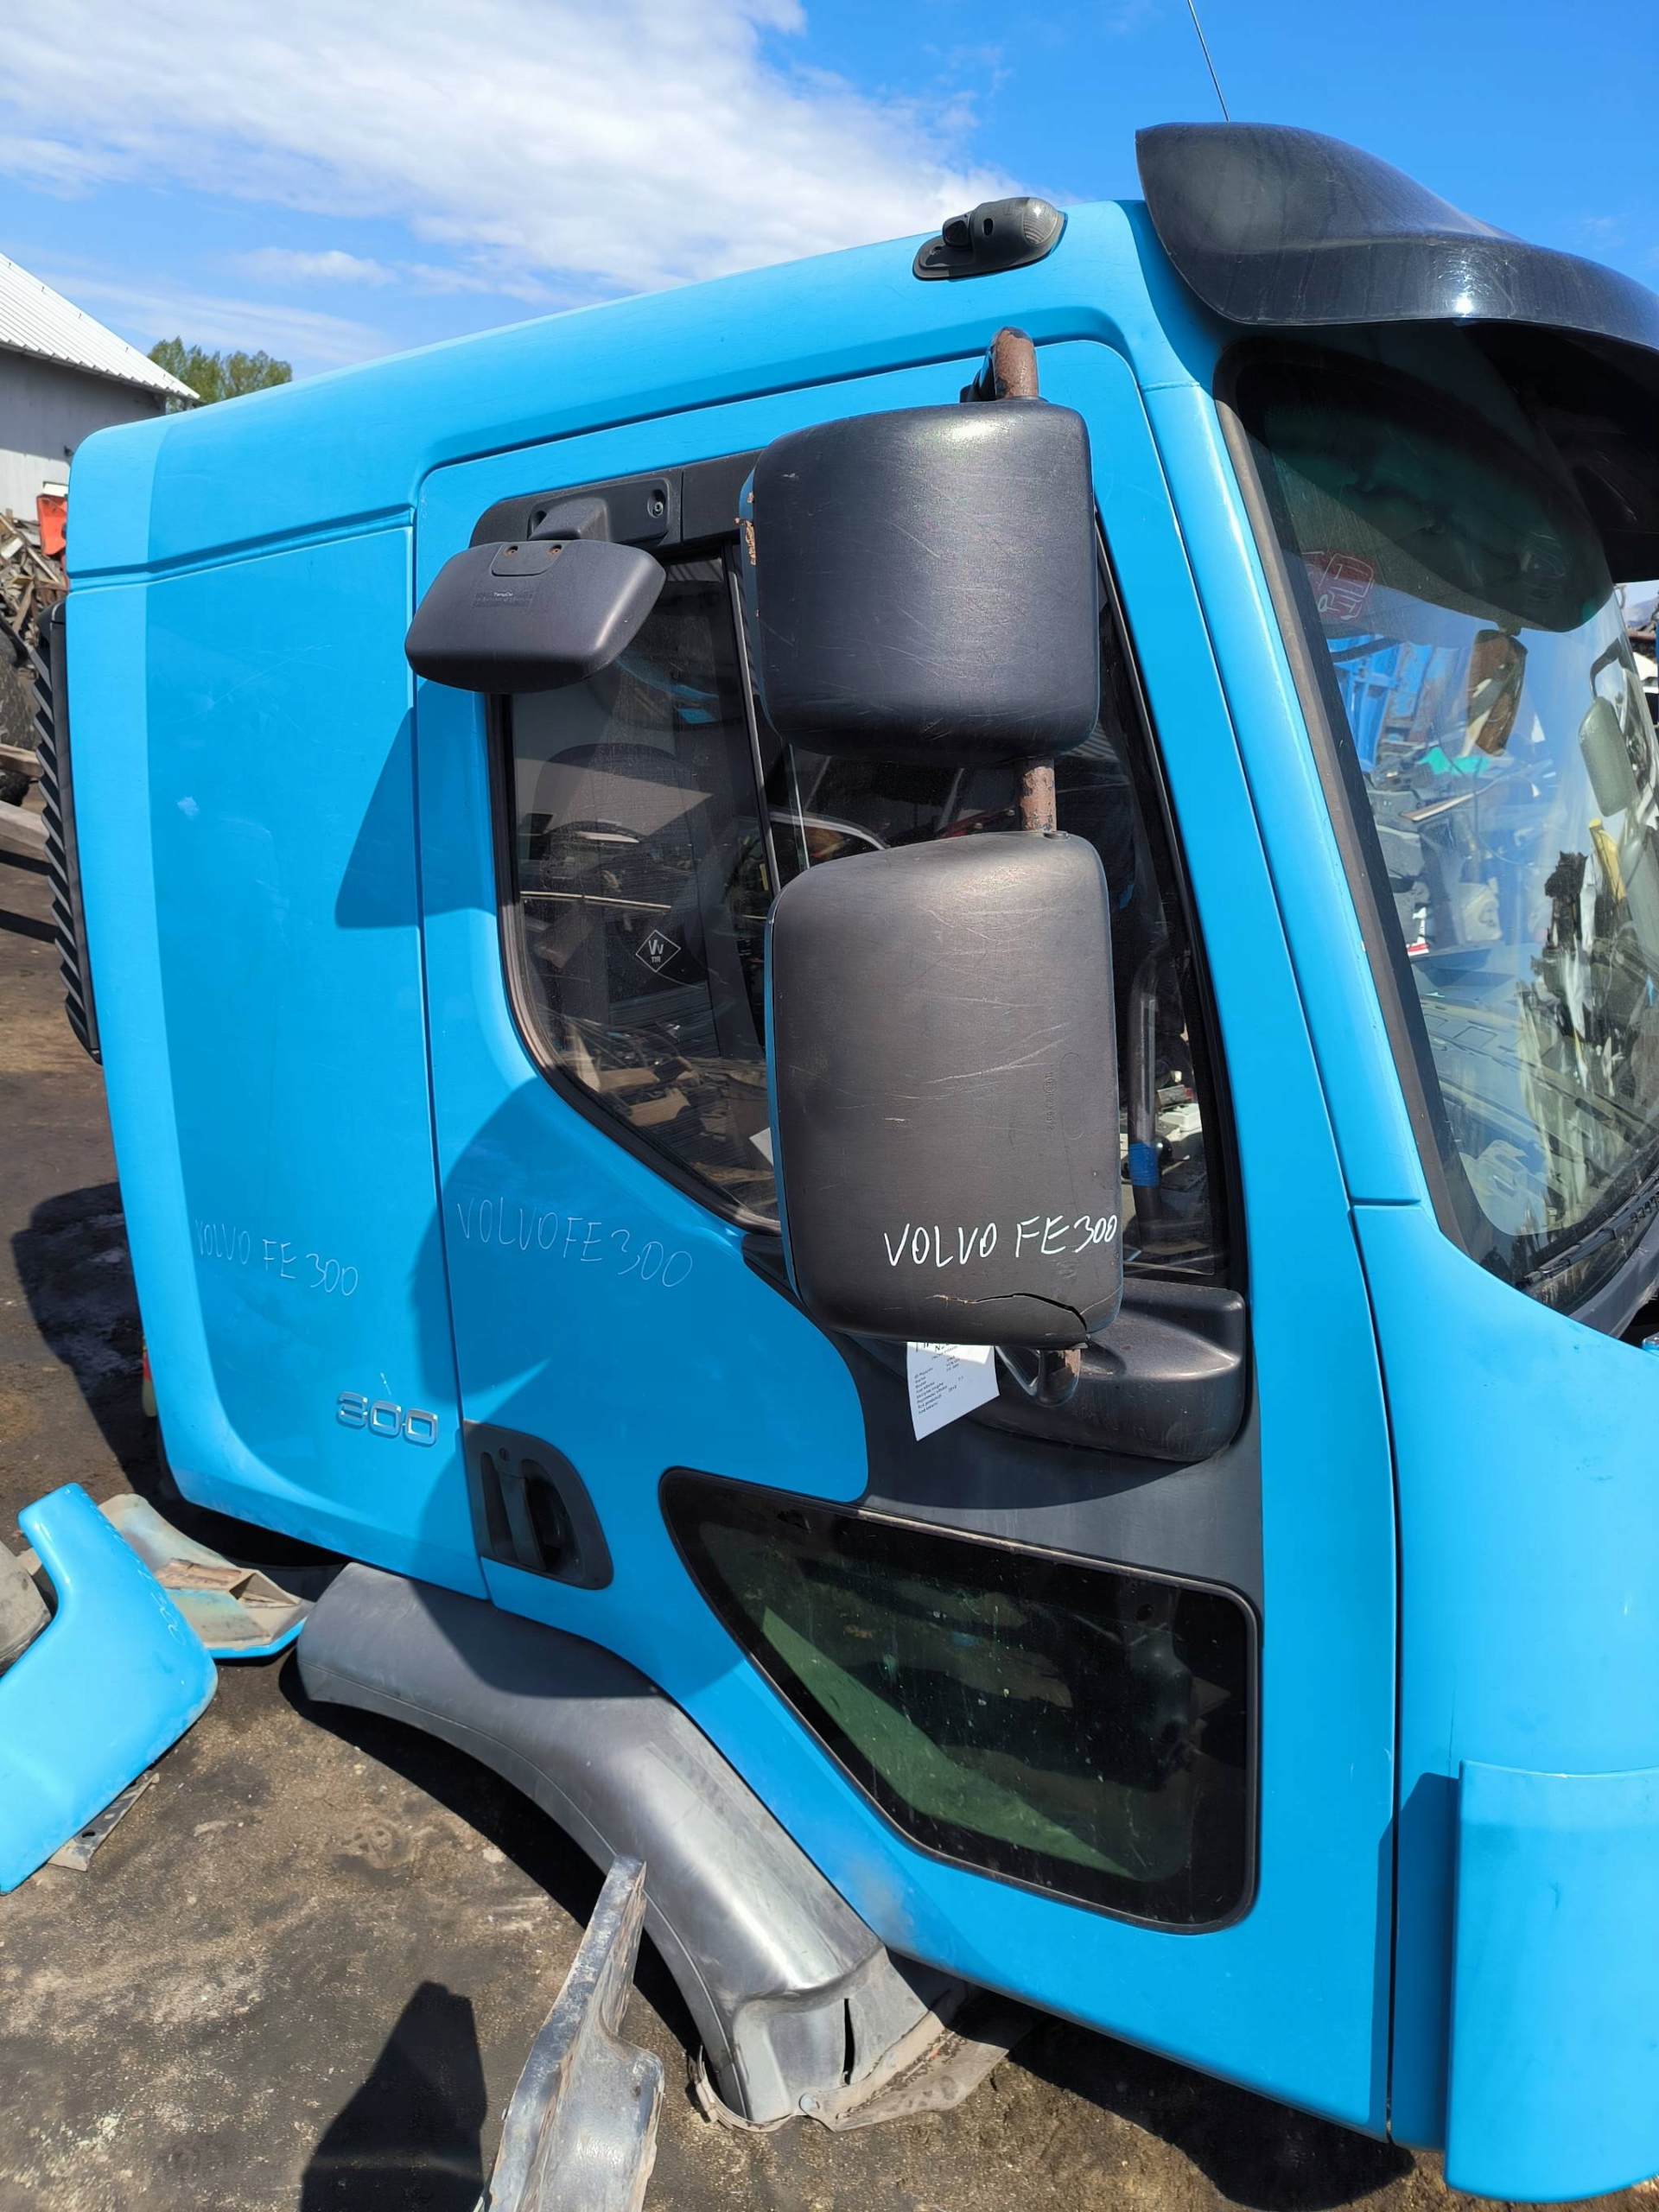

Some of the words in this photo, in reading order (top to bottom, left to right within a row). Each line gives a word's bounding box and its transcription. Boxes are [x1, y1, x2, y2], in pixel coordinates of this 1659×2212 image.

[194, 1219, 251, 1265] VOLVO
[262, 1238, 296, 1280] FE
[305, 1253, 359, 1296] 300
[611, 1229, 693, 1287] 300
[883, 1223, 998, 1268] VOLVO
[1014, 1215, 1071, 1258] FE
[1073, 1214, 1118, 1253] 300
[337, 1390, 438, 1447] 300
